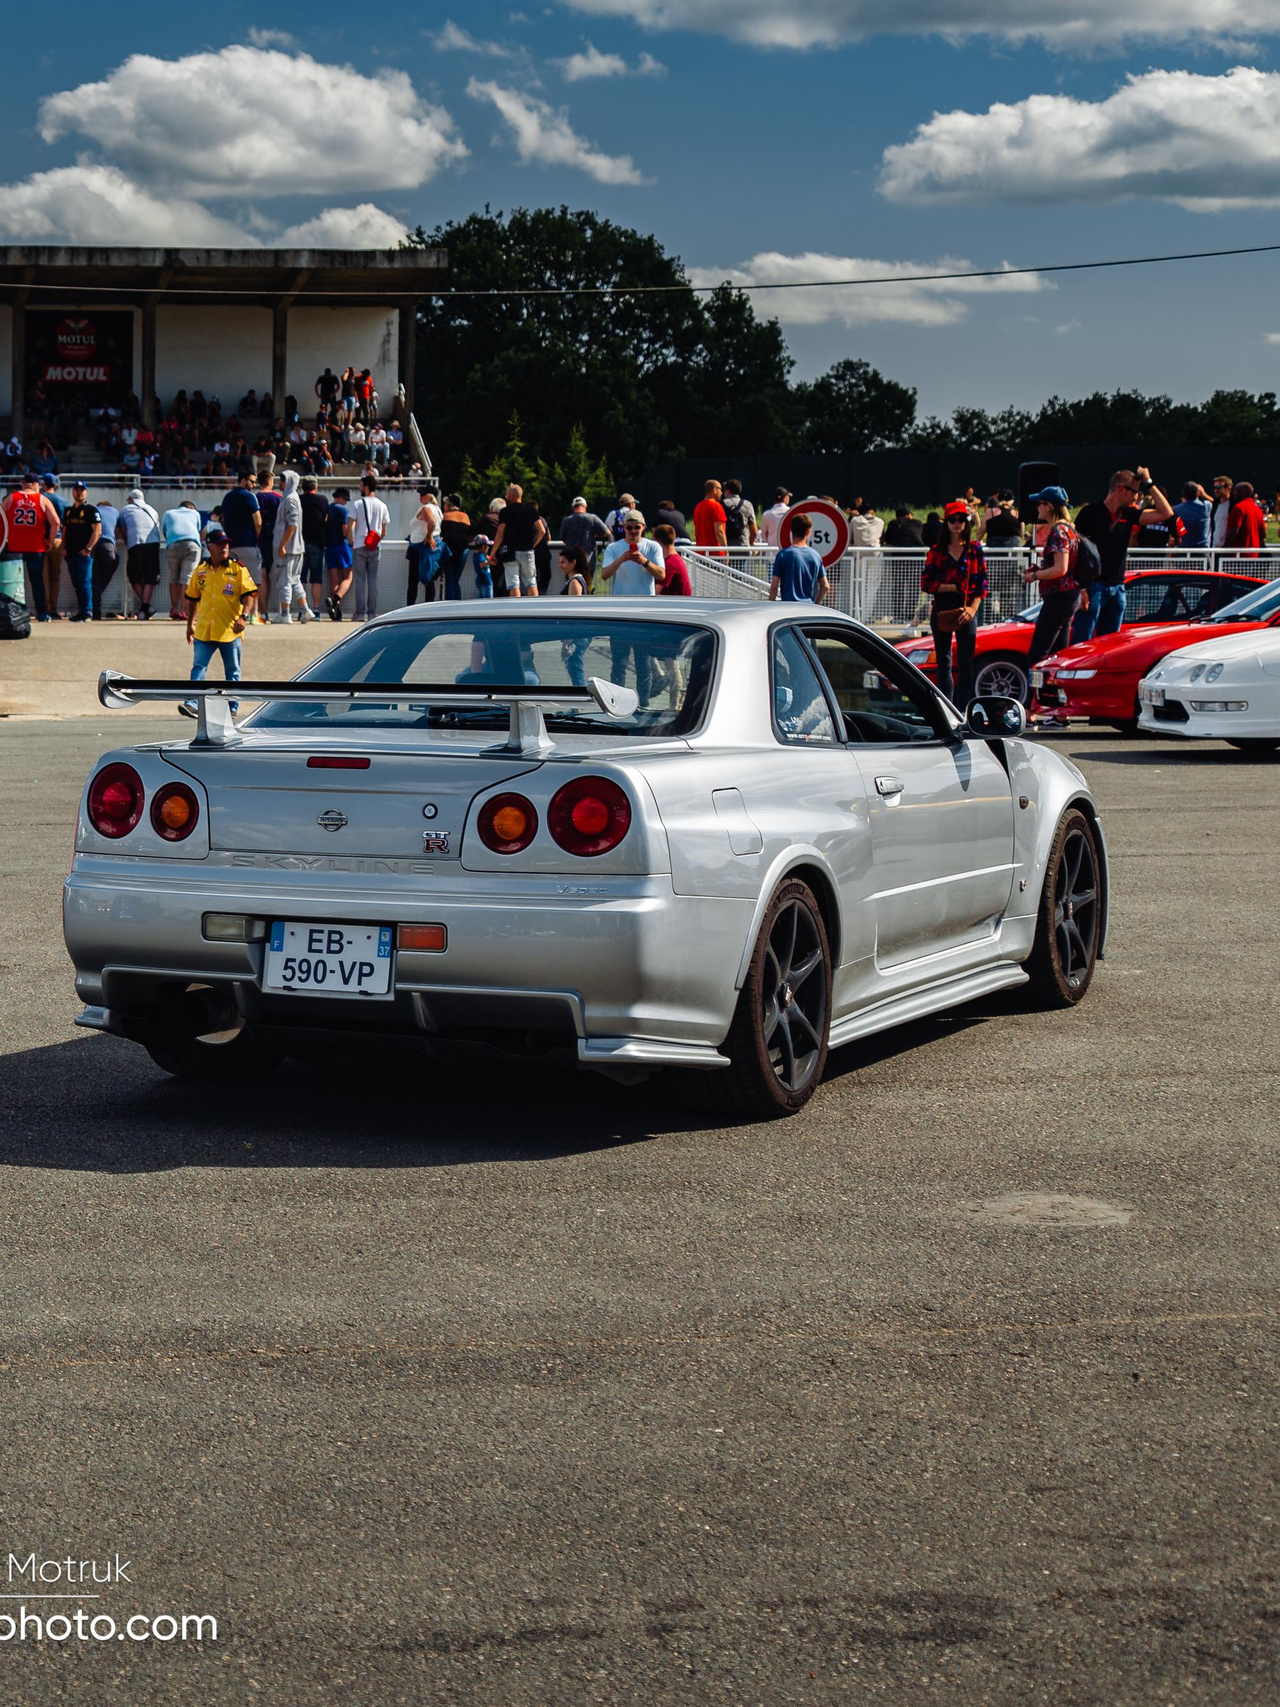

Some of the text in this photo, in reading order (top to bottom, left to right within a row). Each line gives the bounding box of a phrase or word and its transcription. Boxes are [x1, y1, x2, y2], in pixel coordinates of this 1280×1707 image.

[57, 335, 97, 344] MOTUL
[46, 366, 108, 381] MOTUL
[13, 508, 37, 526] 23
[1146, 524, 1169, 533] HONDA
[809, 530, 831, 547] ,5t
[231, 855, 434, 876] SKYLINE
[274, 940, 280, 949] F
[379, 946, 390, 957] 37
[281, 957, 376, 987] 590-VP
